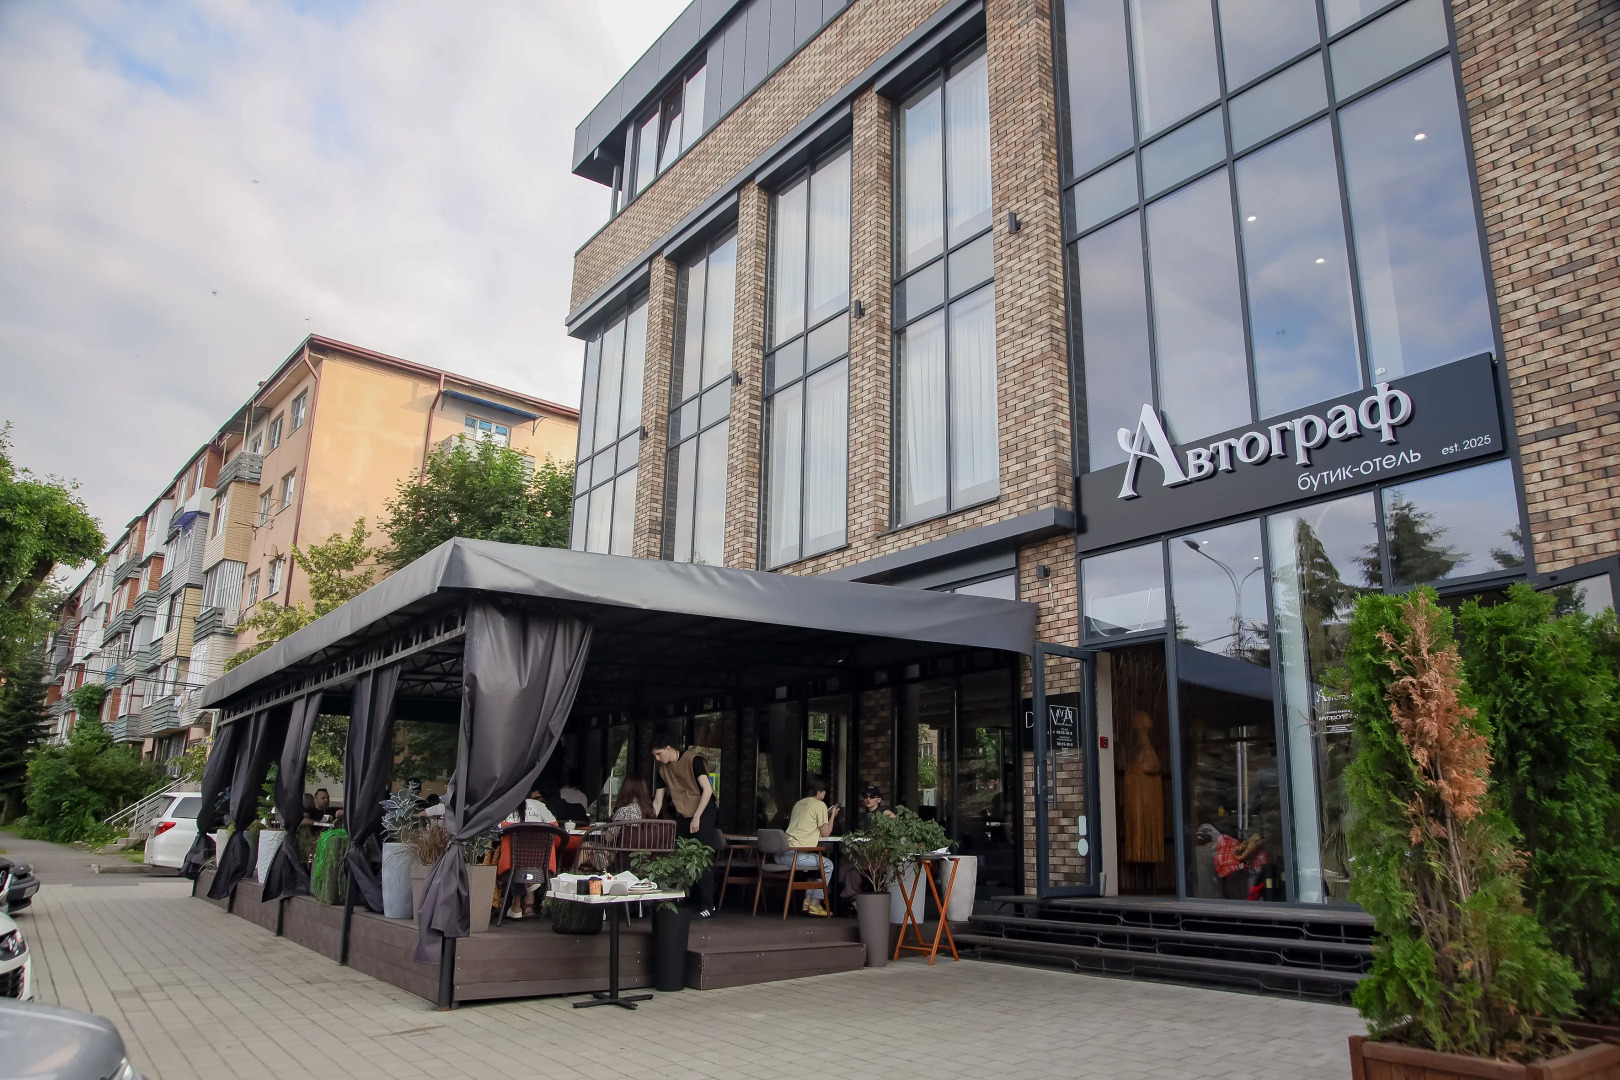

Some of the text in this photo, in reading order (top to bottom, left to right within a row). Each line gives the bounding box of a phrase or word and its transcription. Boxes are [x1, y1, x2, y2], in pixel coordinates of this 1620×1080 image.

[1117, 382, 1412, 498] Автограф
[1441, 434, 1492, 455] est. 2025
[1297, 449, 1422, 491] бутик-отель
